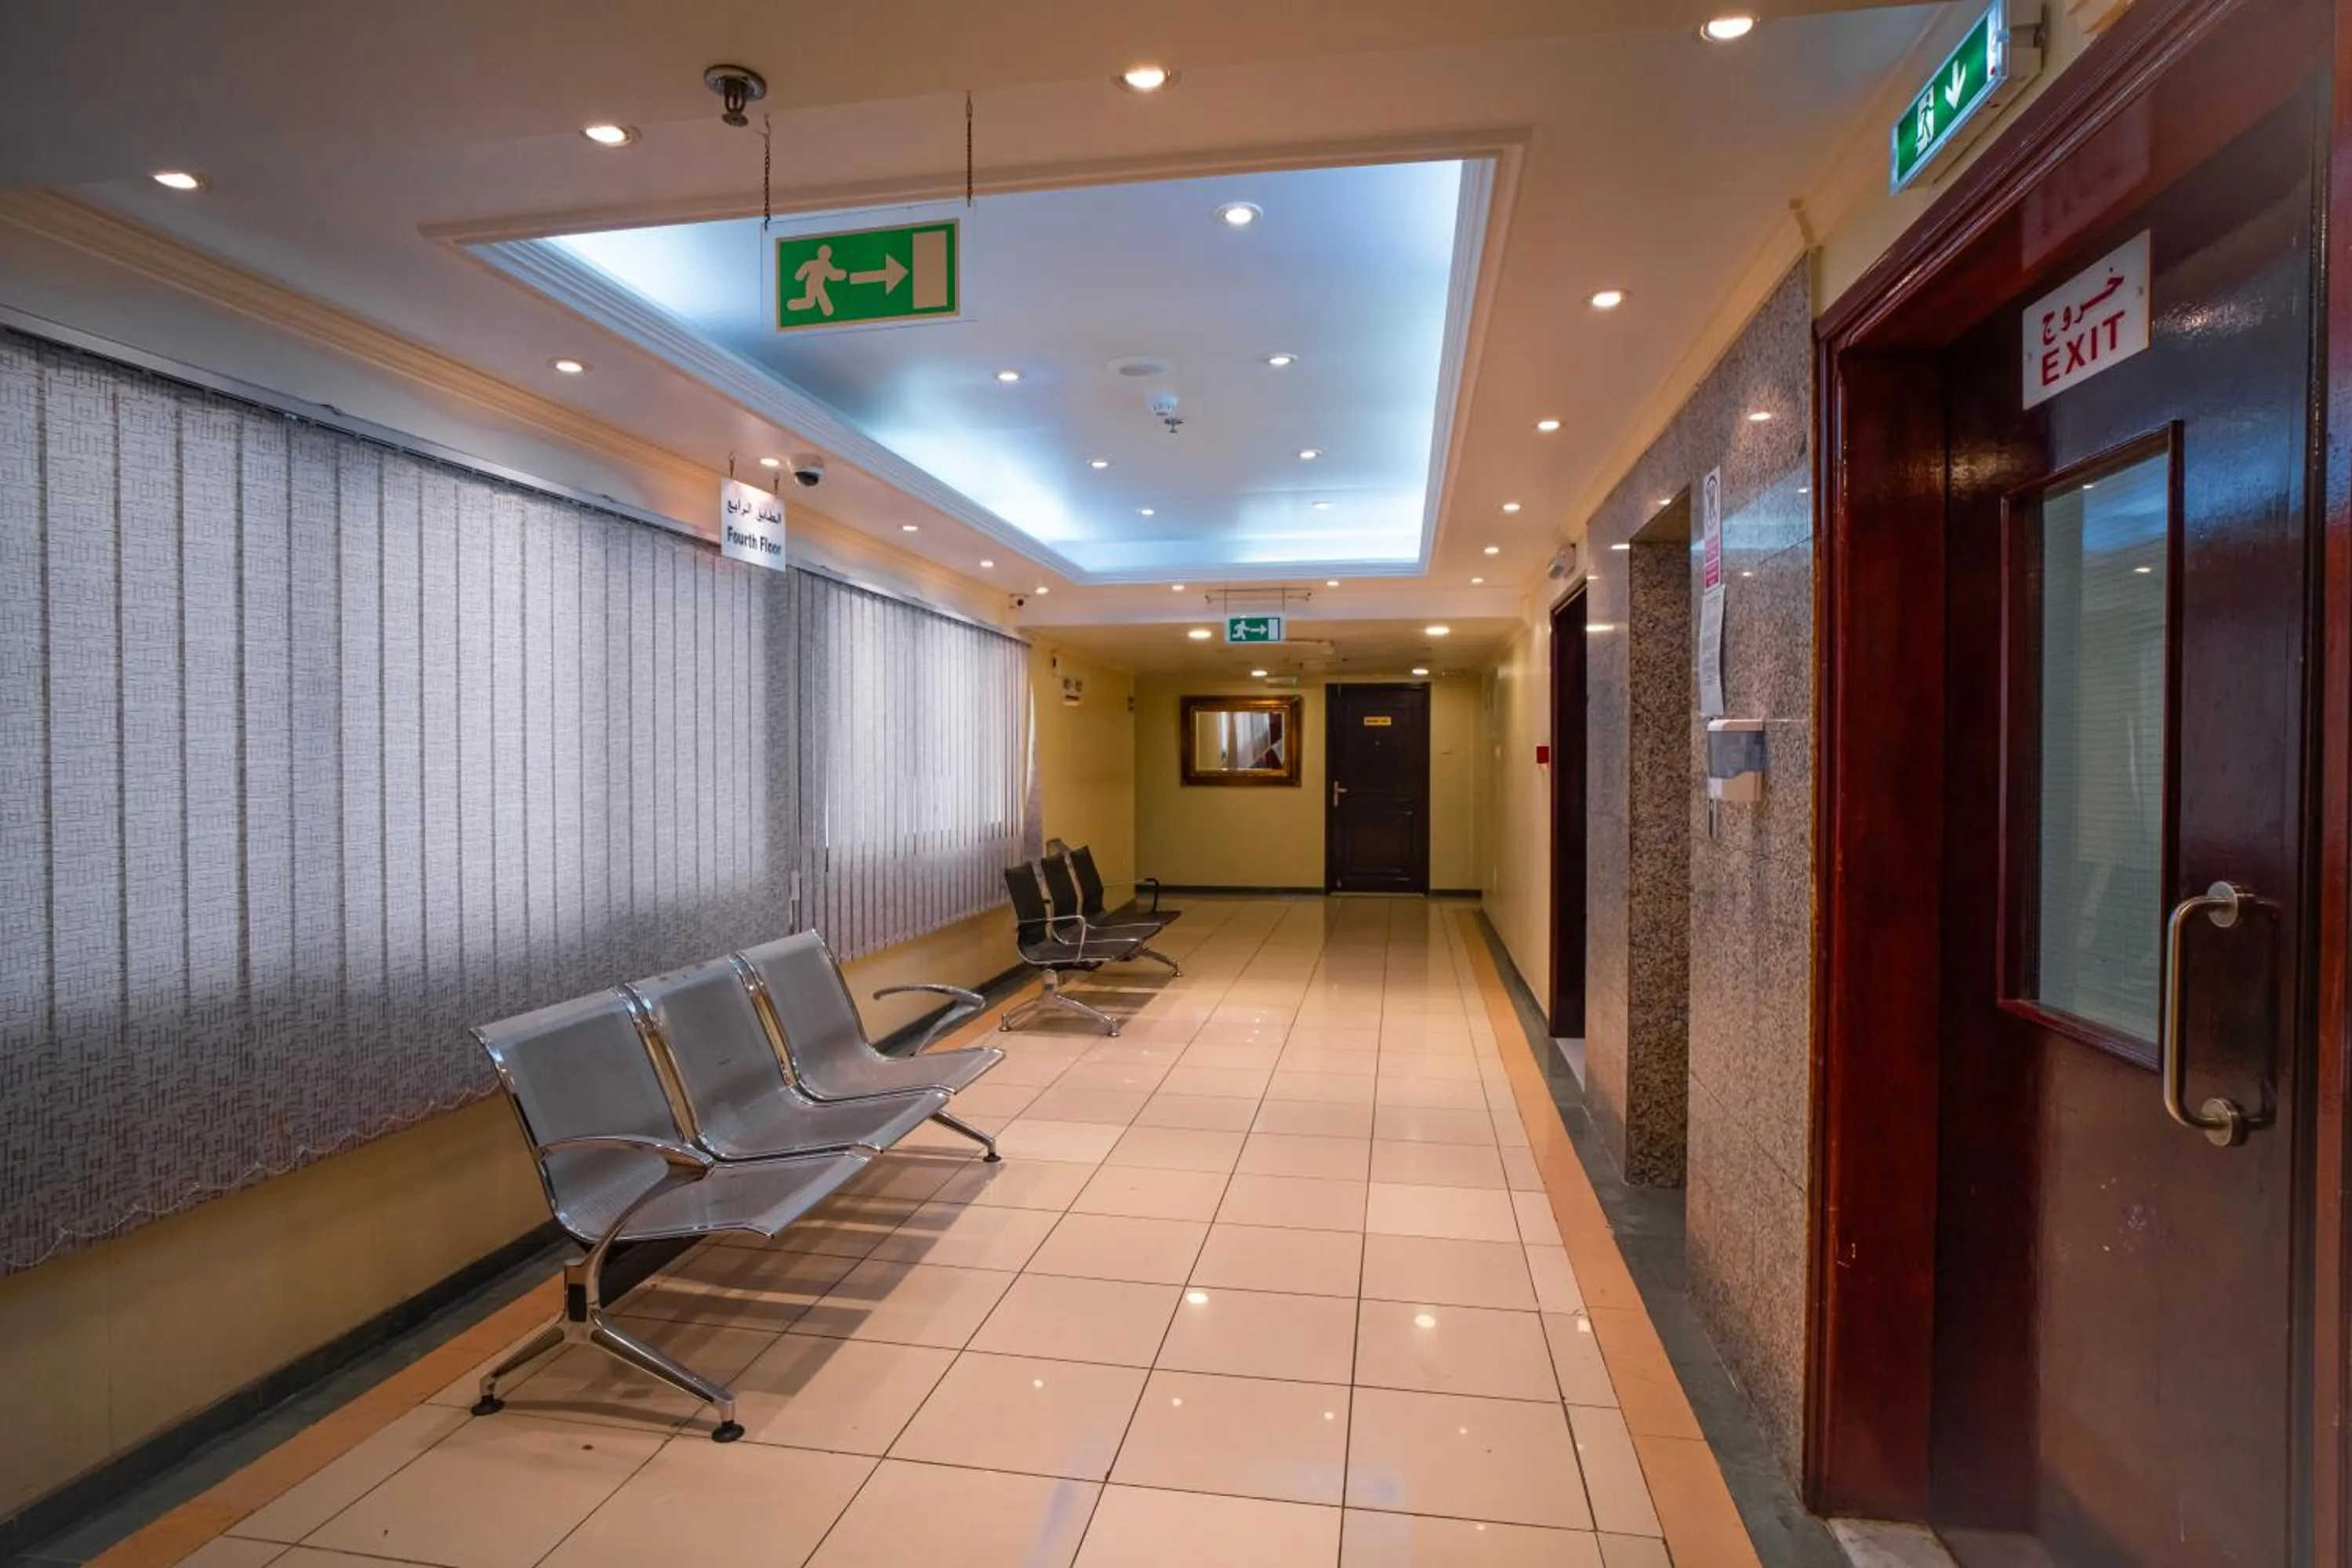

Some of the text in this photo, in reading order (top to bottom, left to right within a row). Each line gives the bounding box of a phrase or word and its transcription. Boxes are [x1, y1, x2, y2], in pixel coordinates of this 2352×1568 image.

[2042, 267, 2125, 346] خروج
[2042, 310, 2125, 387] EXIT
[727, 525, 782, 555] Fourth Floor
